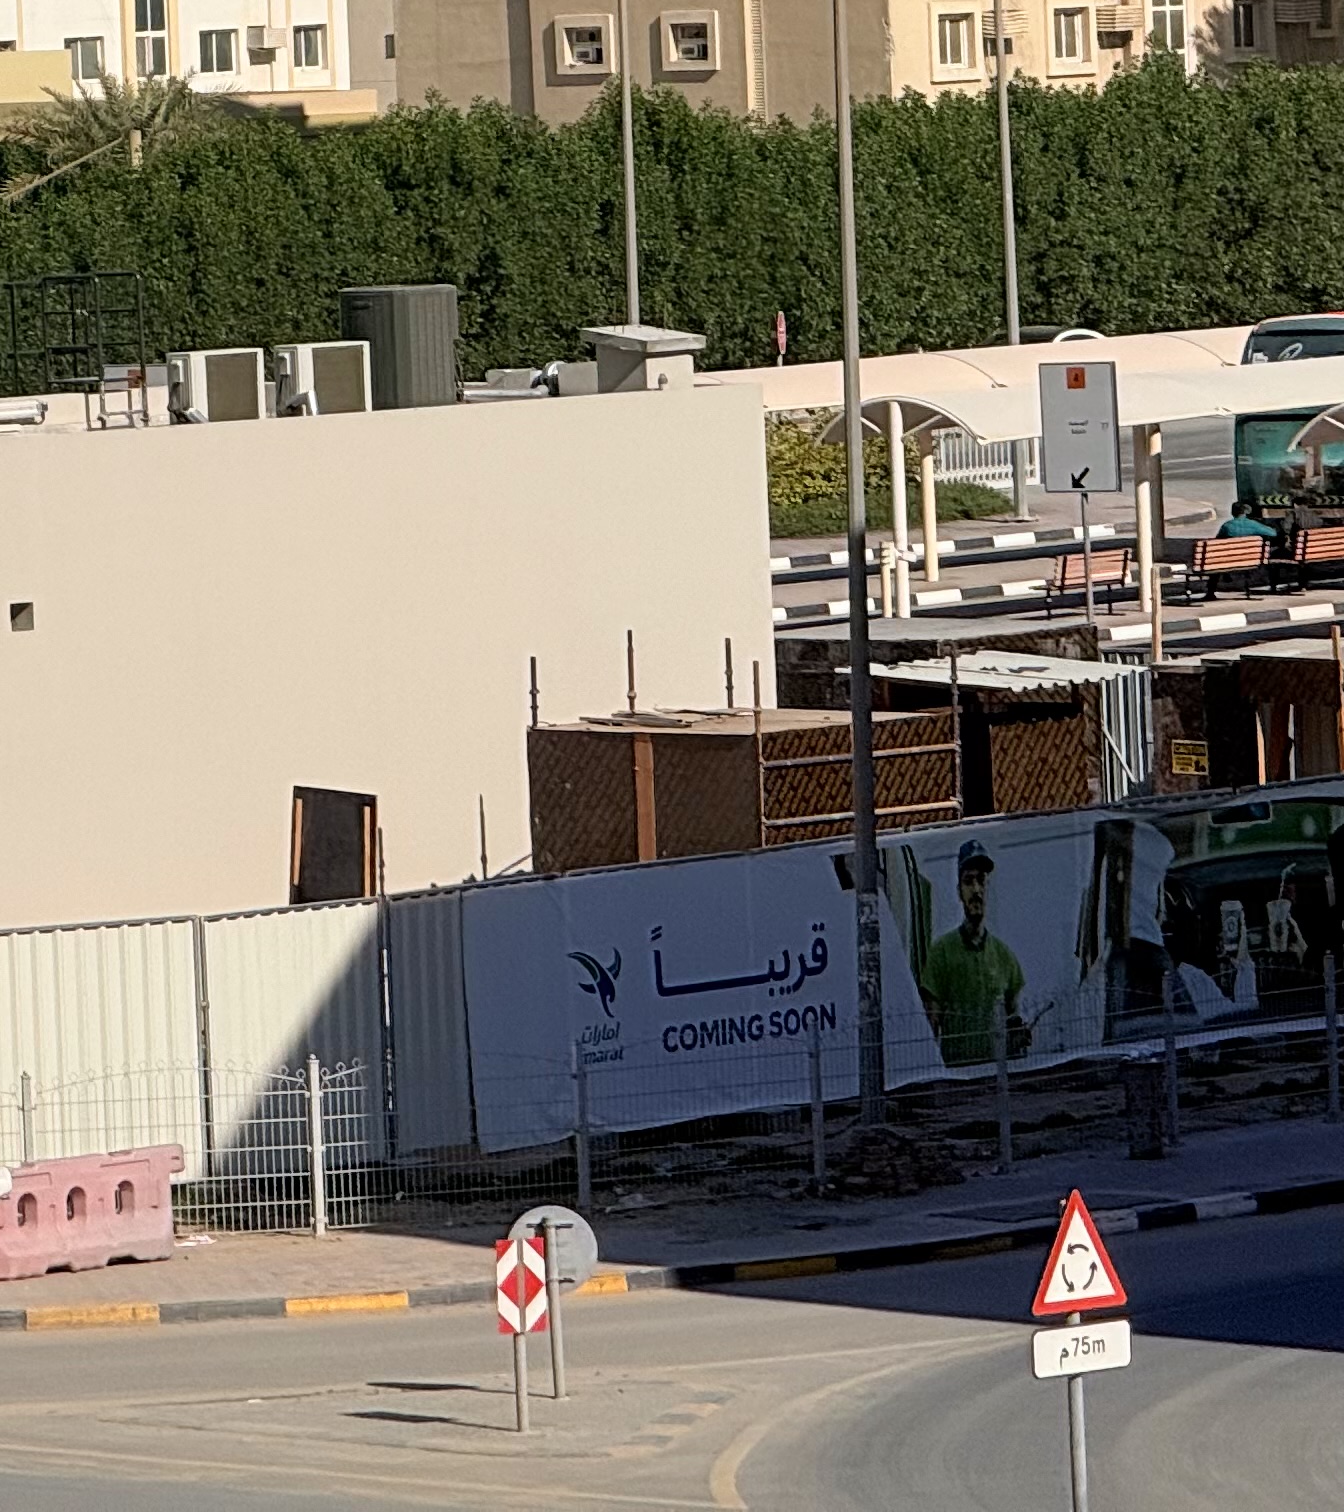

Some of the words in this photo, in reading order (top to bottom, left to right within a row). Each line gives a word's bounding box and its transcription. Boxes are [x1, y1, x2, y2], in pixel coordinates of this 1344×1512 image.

[662, 1013, 764, 1053] COMING
[768, 1002, 837, 1038] SOON
[577, 1045, 624, 1065] marat
